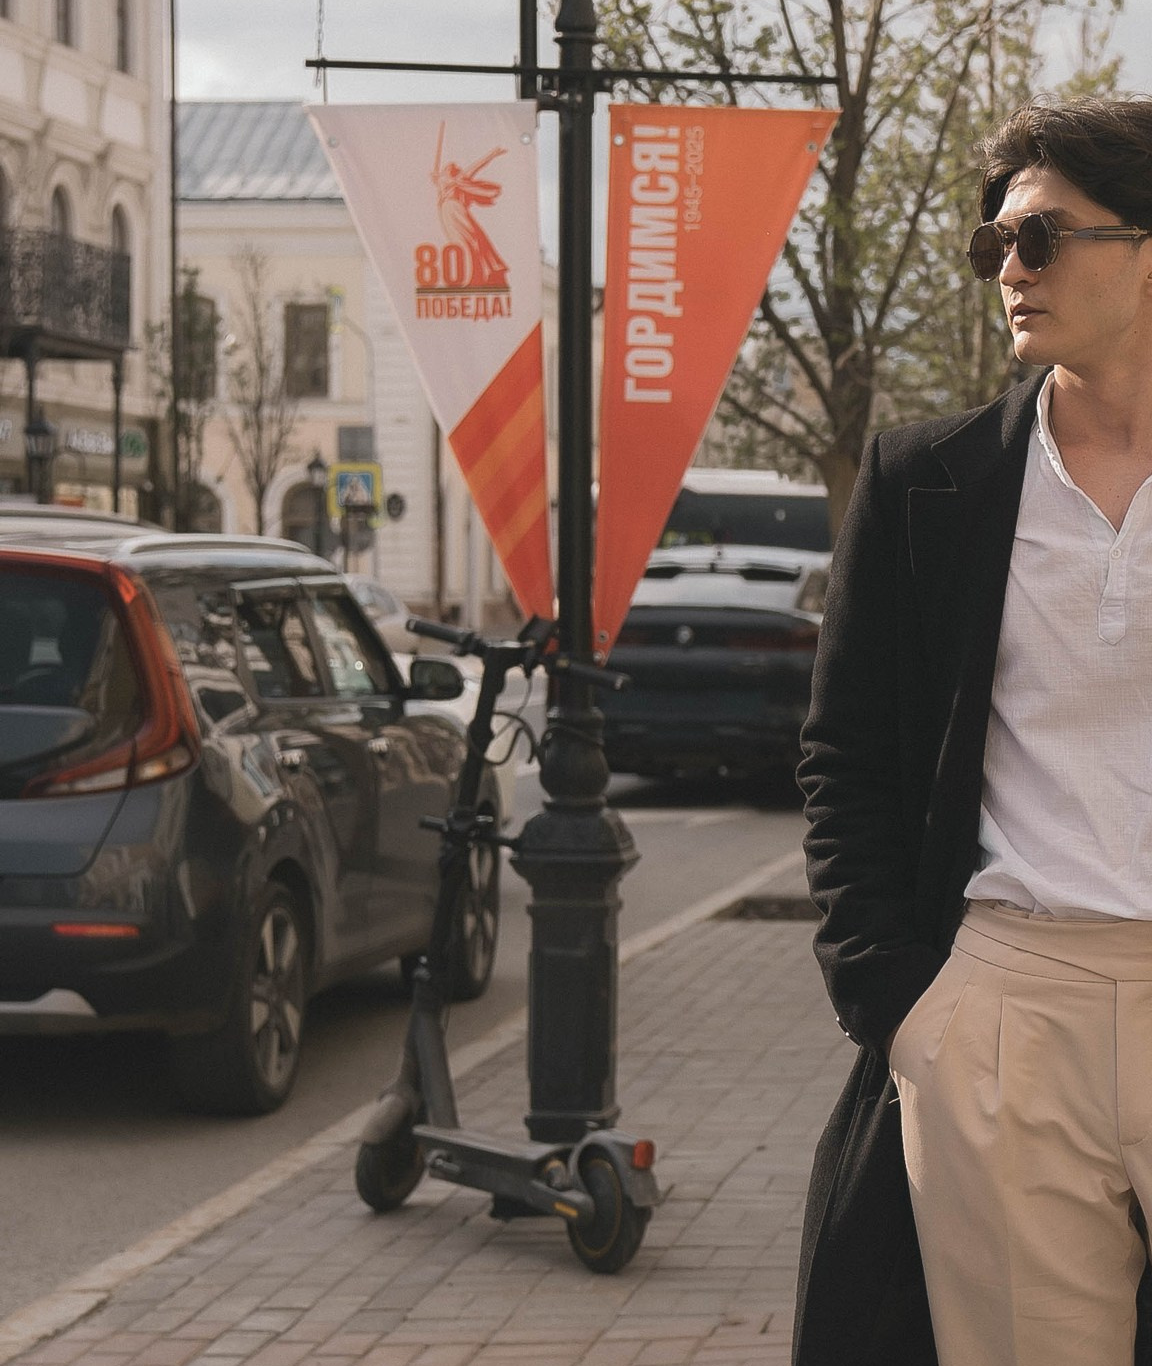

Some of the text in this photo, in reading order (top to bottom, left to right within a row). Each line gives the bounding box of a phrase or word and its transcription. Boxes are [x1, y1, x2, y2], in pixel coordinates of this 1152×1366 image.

[415, 243, 465, 288] 80
[624, 124, 684, 403] ГОРДИМСЯ!
[417, 296, 511, 322] ПОБЕДА!
